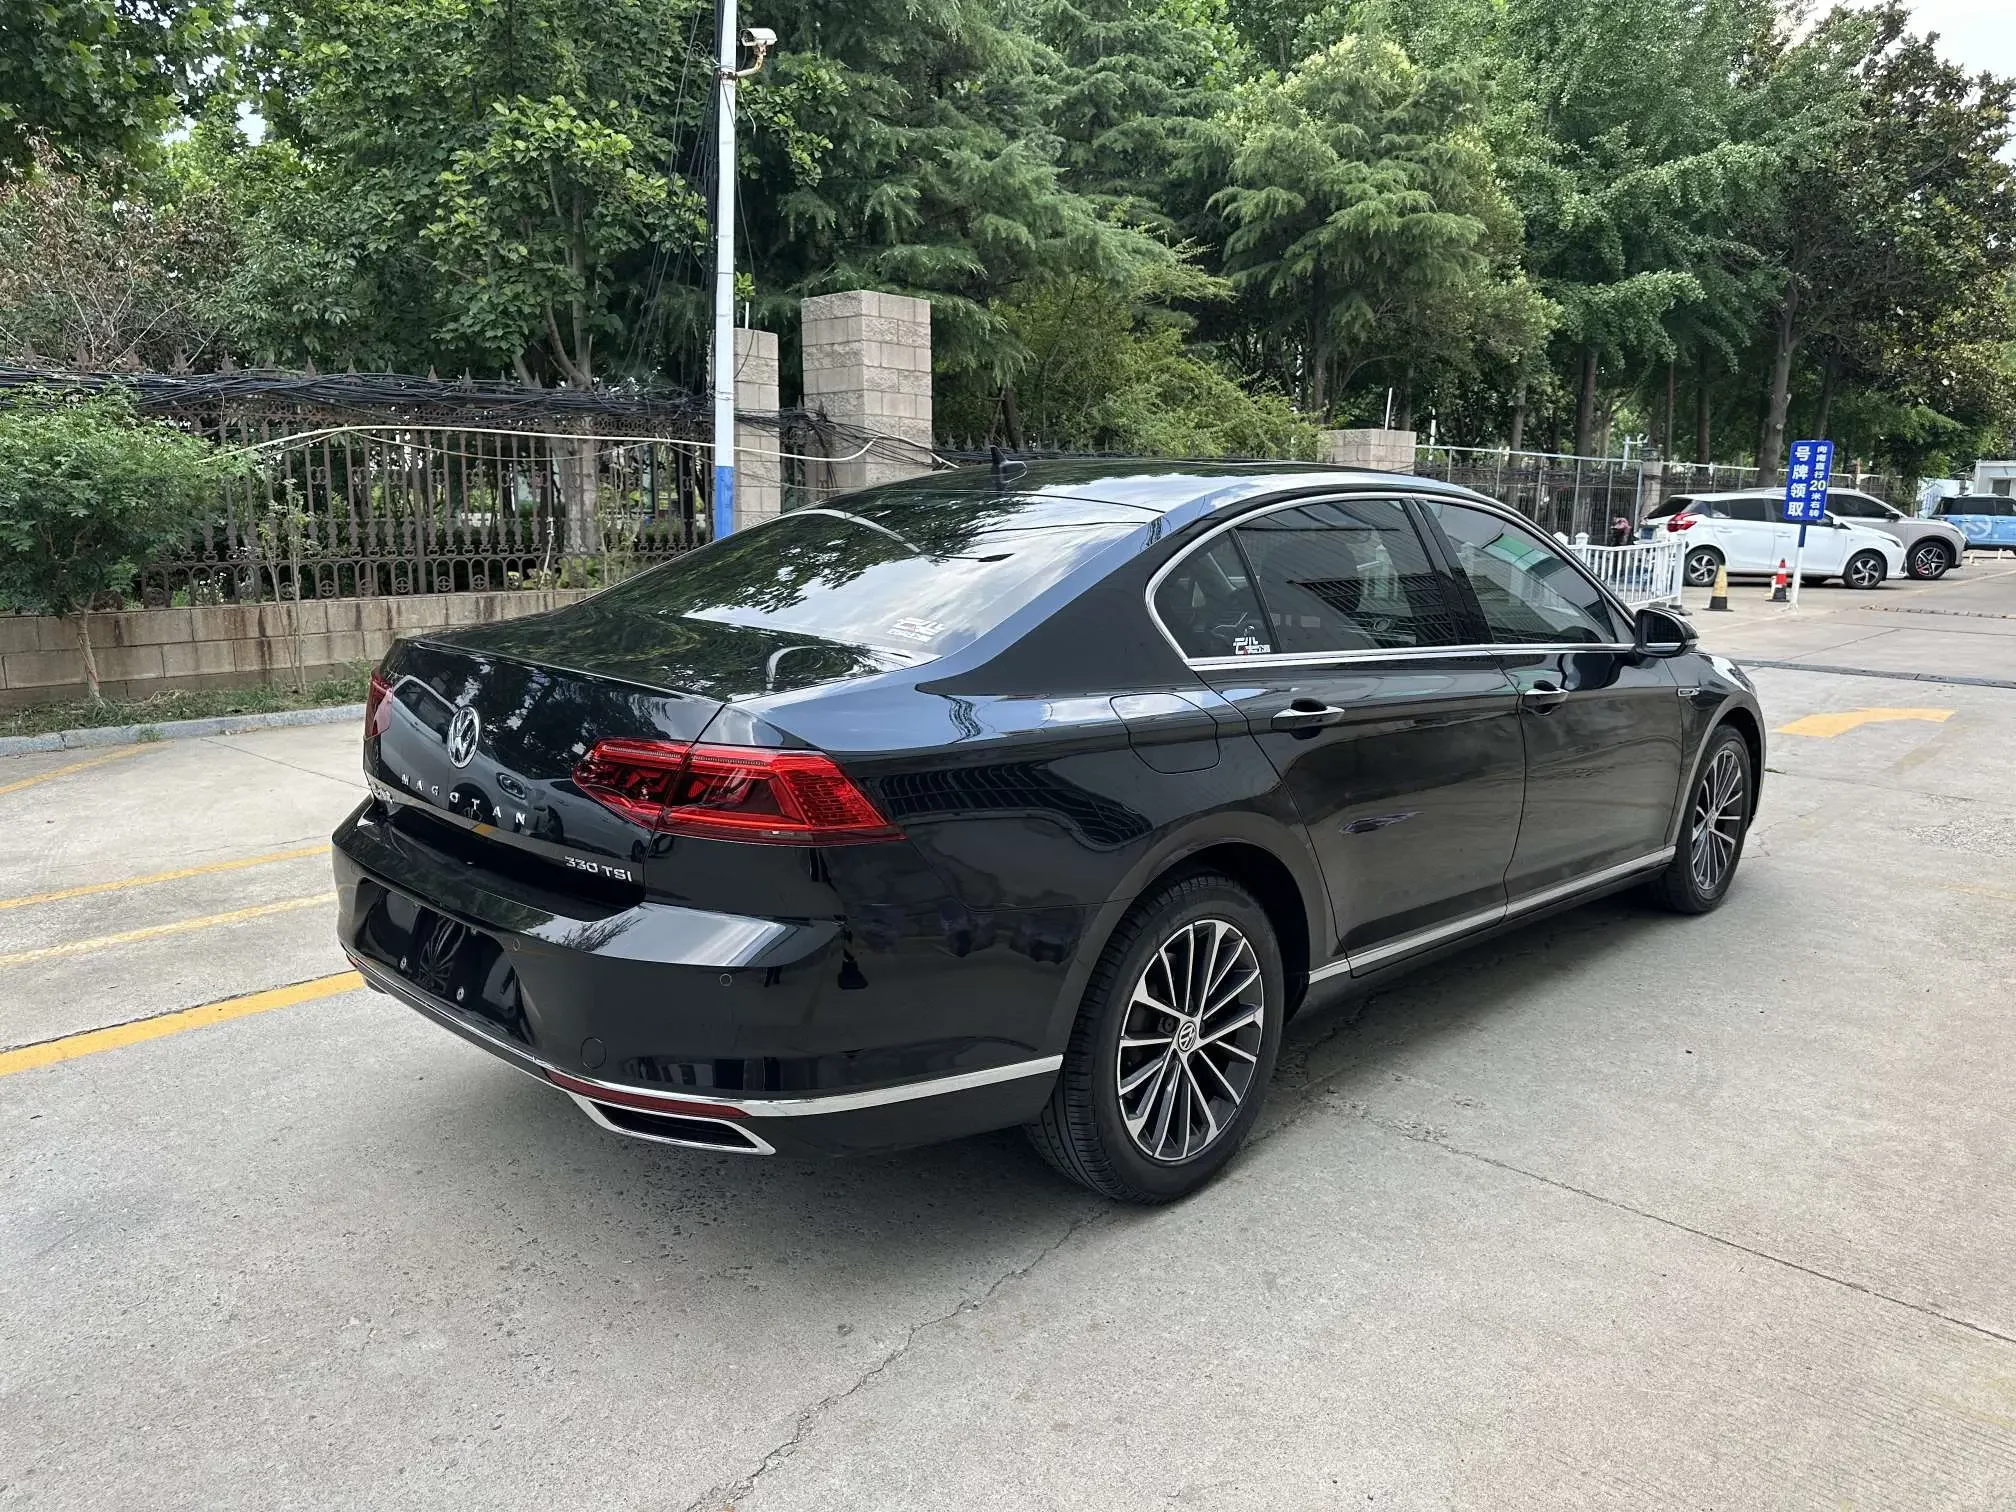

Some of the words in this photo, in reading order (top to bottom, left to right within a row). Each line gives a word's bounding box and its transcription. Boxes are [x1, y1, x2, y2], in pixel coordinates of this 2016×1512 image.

[1787, 445, 1811, 517] 号牌领取
[401, 773, 526, 825] MAGOTAN
[564, 855, 599, 873] 330
[601, 865, 633, 882] TSI
